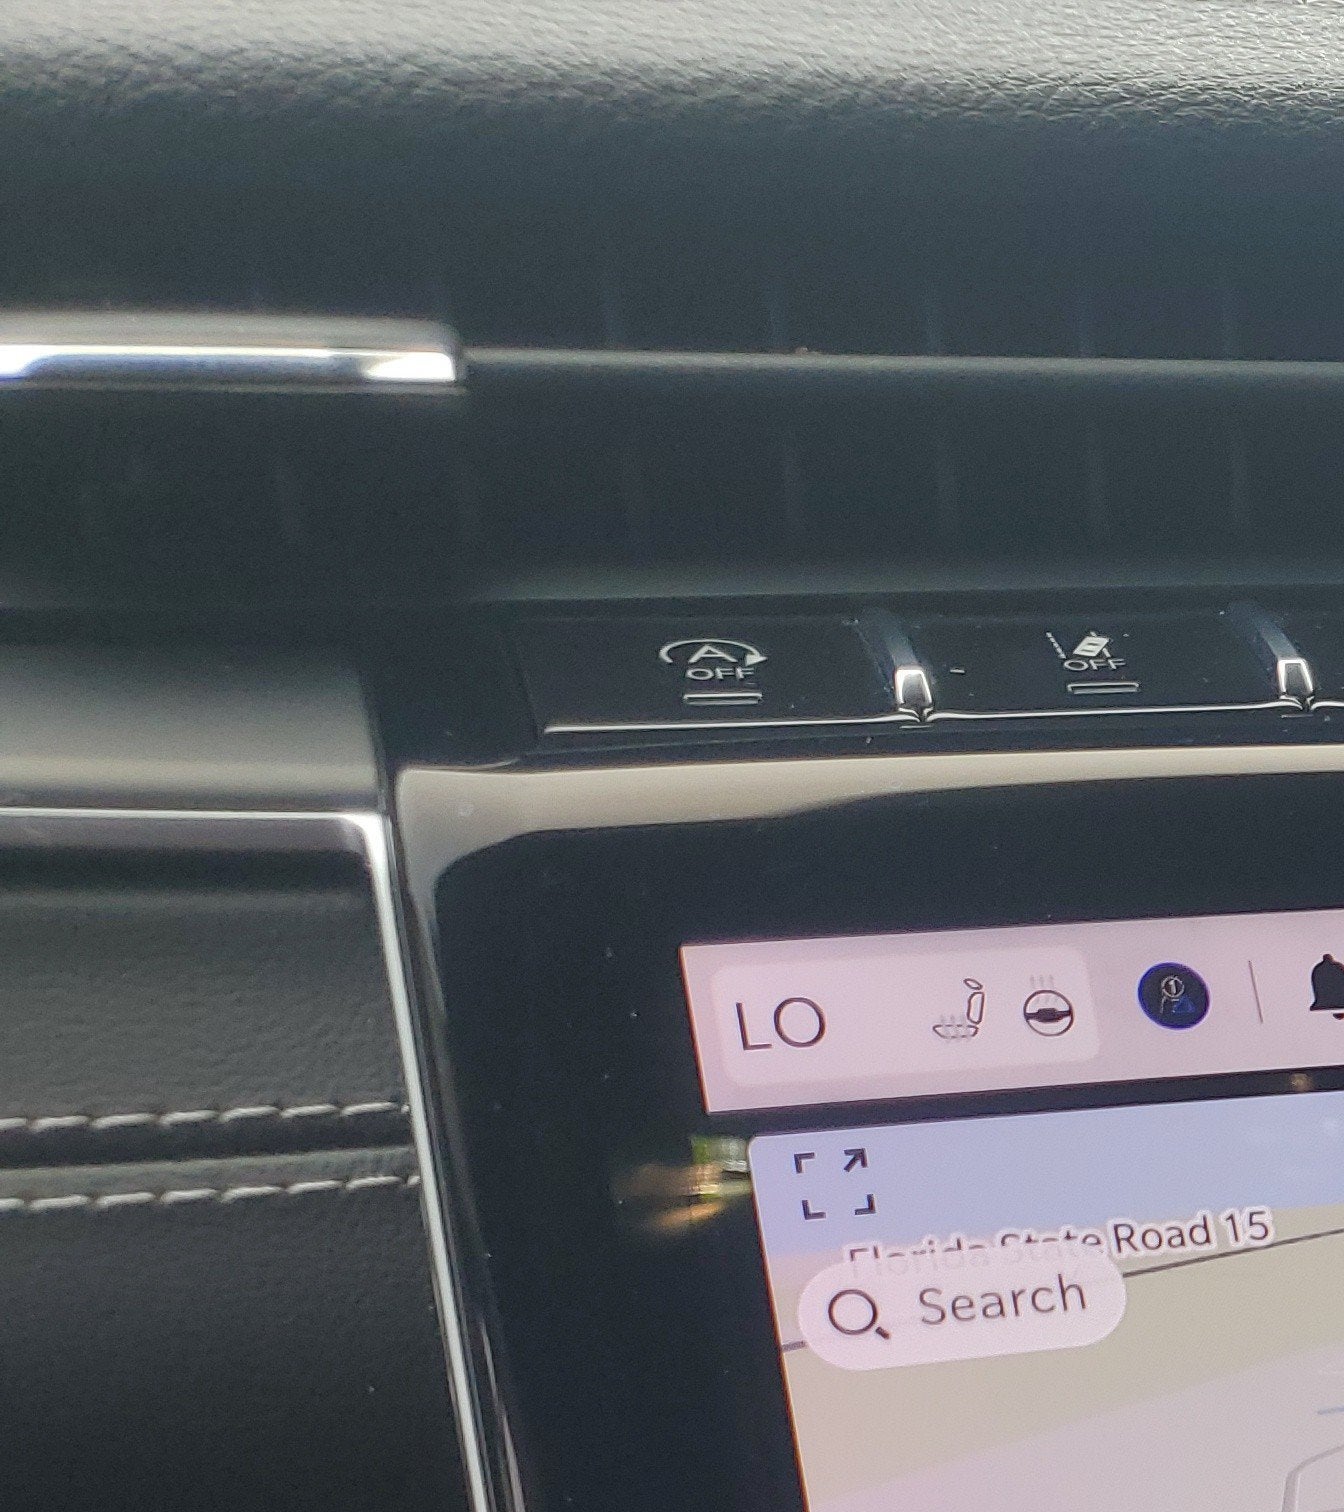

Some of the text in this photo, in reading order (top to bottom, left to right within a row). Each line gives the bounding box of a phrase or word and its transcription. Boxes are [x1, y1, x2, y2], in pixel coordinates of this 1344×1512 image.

[685, 667, 755, 681] OFF
[1063, 658, 1126, 671] OFF
[735, 996, 826, 1051] LO
[1113, 1211, 1212, 1254] Road
[1224, 1210, 1270, 1244] 15
[919, 1273, 1087, 1326] Search
